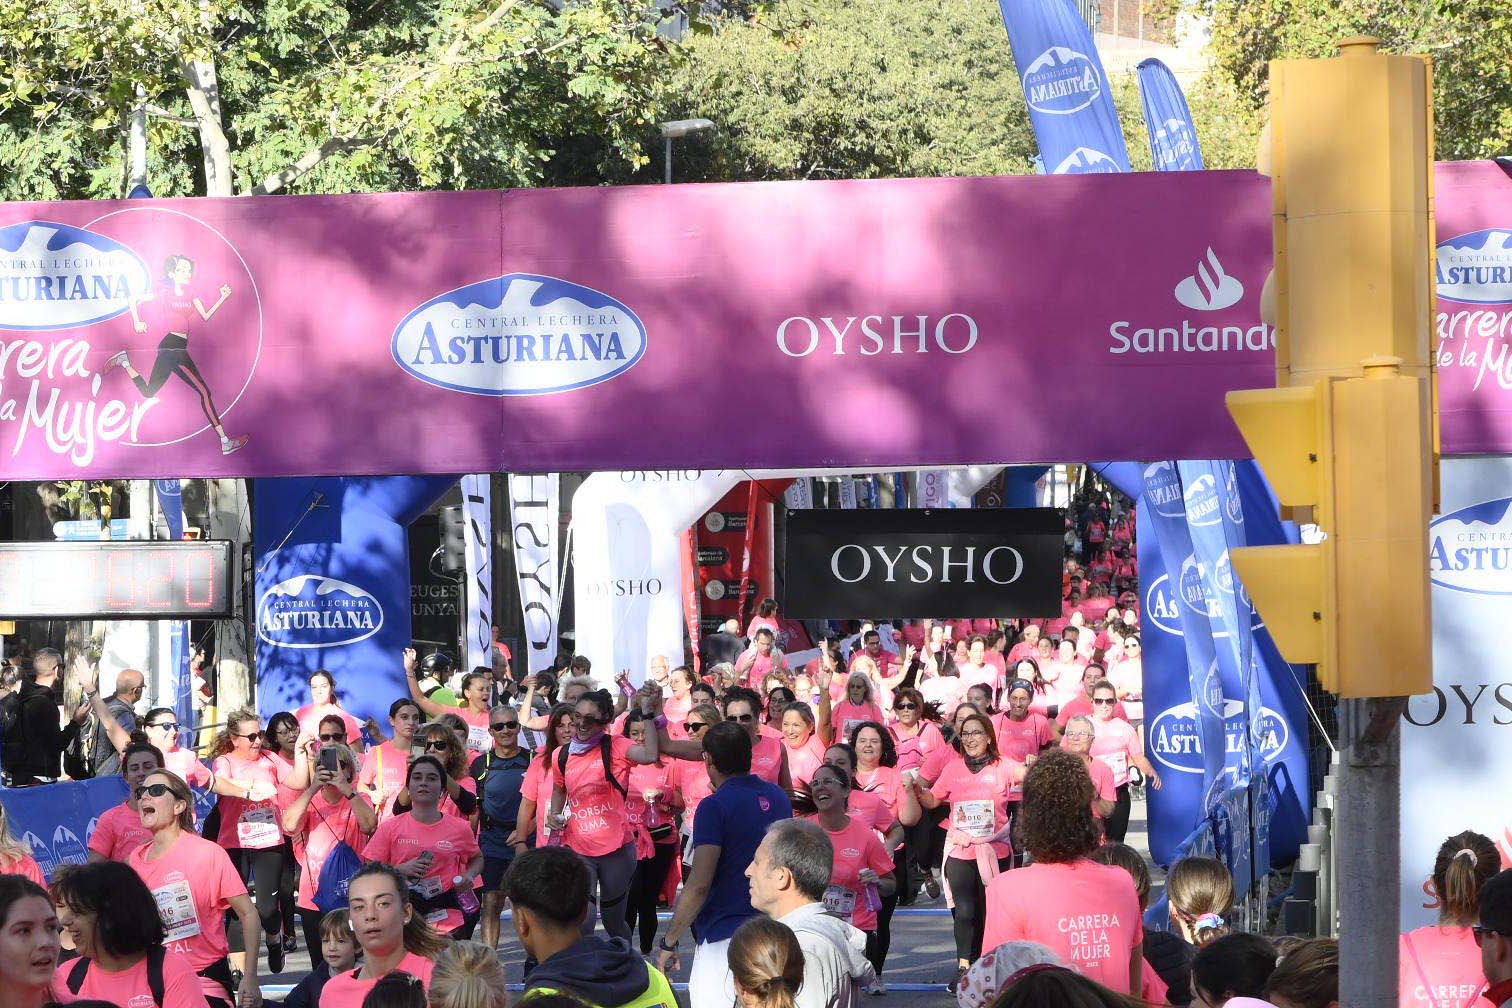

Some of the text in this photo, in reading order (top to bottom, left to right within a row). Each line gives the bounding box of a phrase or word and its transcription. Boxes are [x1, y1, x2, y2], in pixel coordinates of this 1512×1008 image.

[1450, 255, 1501, 263] CENTRAL
[451, 314, 618, 328] CENTRAL LECHERA
[411, 321, 626, 364] ASTURIANA
[777, 313, 978, 357] OYSHO
[1460, 340, 1477, 367] la
[12, 374, 160, 467] Mujer
[831, 544, 1024, 585] OYSHO
[588, 579, 662, 596] OYSHO
[274, 600, 315, 608] CENTRAL
[262, 607, 375, 630] ASTURIANA
[1058, 914, 1120, 932] CARRERA
[1071, 931, 1108, 945] DE LA
[1071, 944, 1111, 960] MUJER
